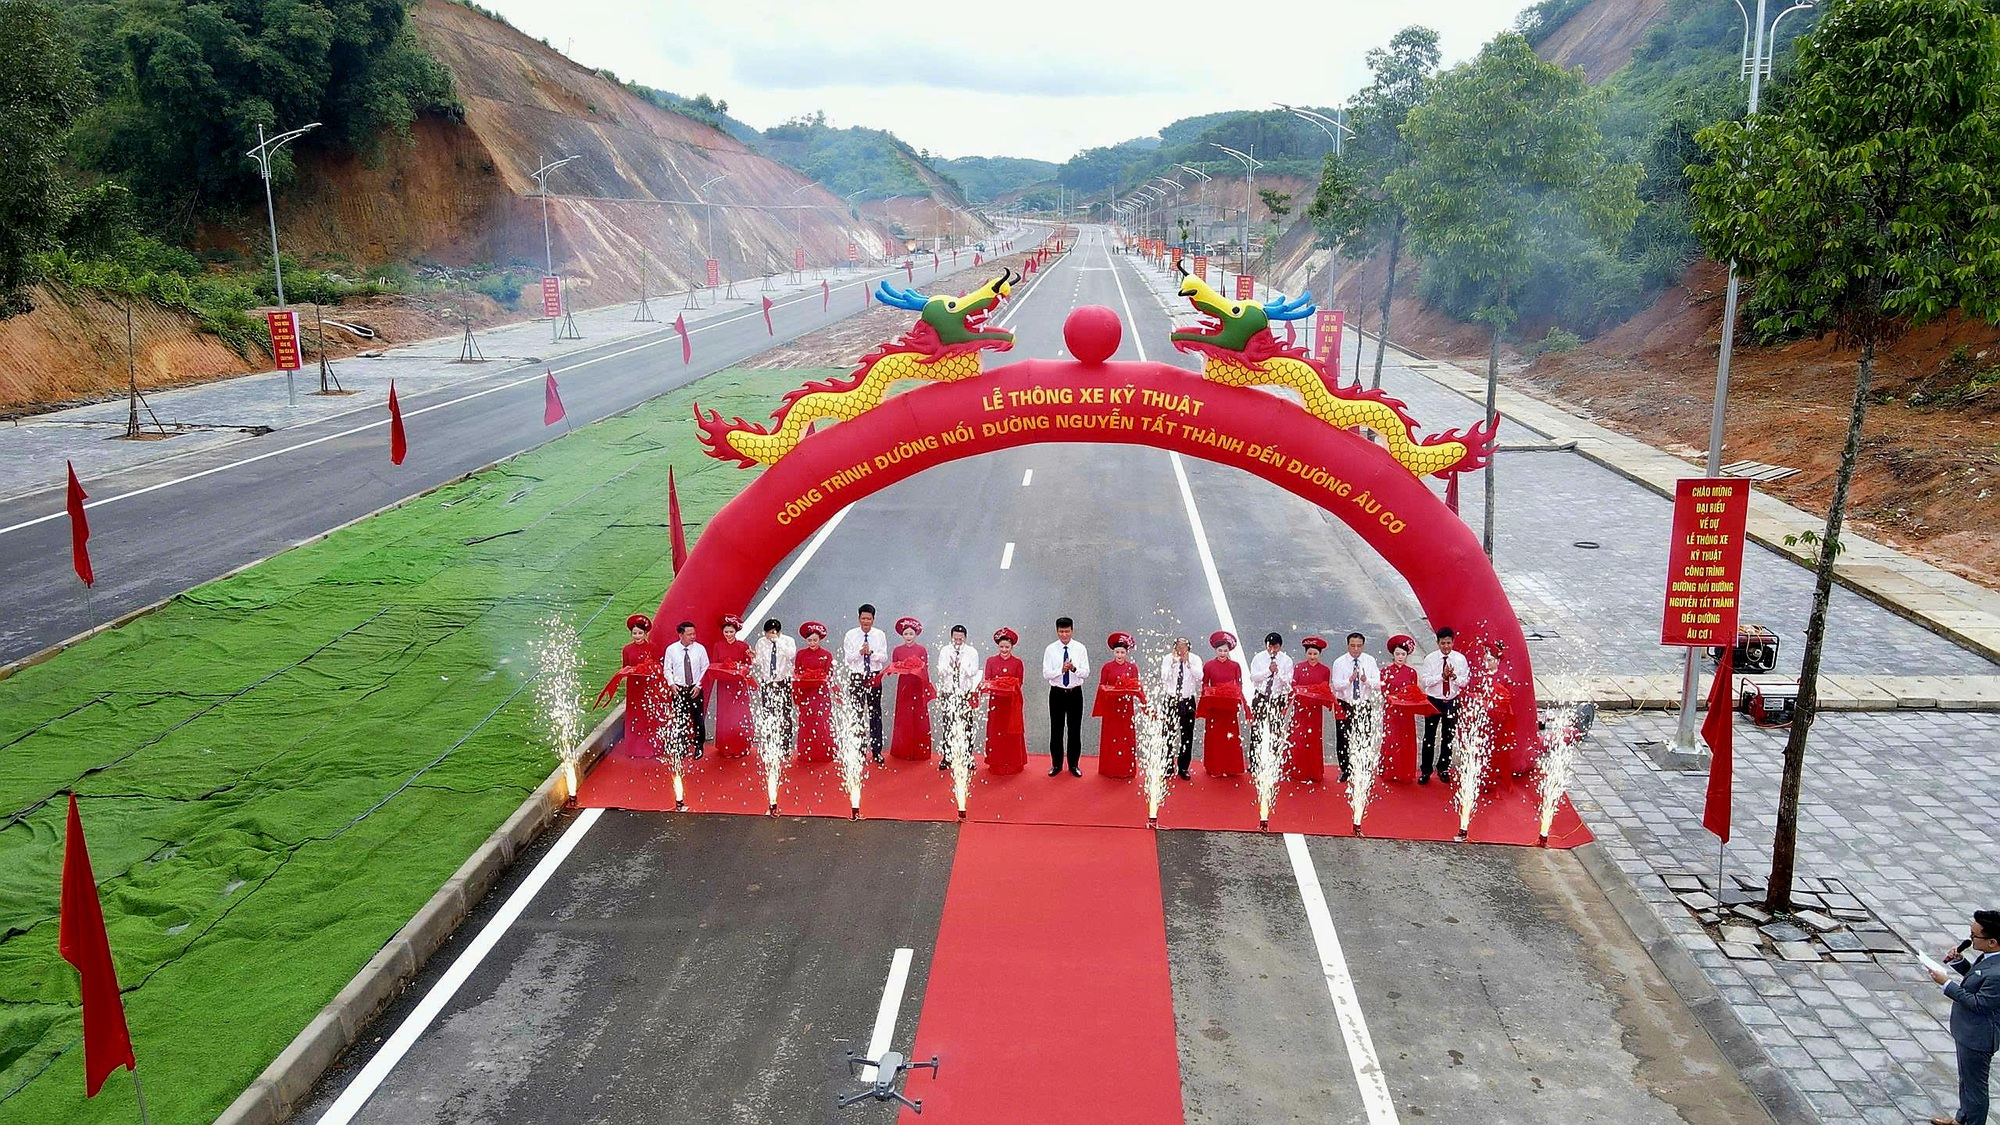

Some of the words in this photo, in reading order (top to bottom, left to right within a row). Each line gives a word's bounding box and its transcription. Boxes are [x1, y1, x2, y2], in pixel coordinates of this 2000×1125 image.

[983, 388, 1003, 412] LỄ
[1008, 387, 1072, 406] THÔNG
[1079, 388, 1103, 404] XE
[1110, 385, 1136, 404] KỸ
[1141, 389, 1204, 417] THUẬT
[776, 490, 822, 525] CÔNG
[820, 461, 873, 493] TRÌNH
[874, 435, 939, 470] ĐƯỜNG
[941, 421, 975, 448] NỐI
[982, 413, 1050, 438] ĐƯỜNG
[1056, 408, 1134, 430] NGUYỄN
[1141, 414, 1177, 435] TẤT
[1182, 424, 1244, 454] THÀNH
[1246, 443, 1285, 469] ĐẾN
[1286, 459, 1352, 497] ĐƯỜNG
[1351, 490, 1382, 515] ÂU
[1378, 511, 1408, 535] CƠ
[1692, 485, 1711, 497] CHÀO
[1719, 534, 1729, 545] XE
[1684, 565, 1704, 576] CÔNG
